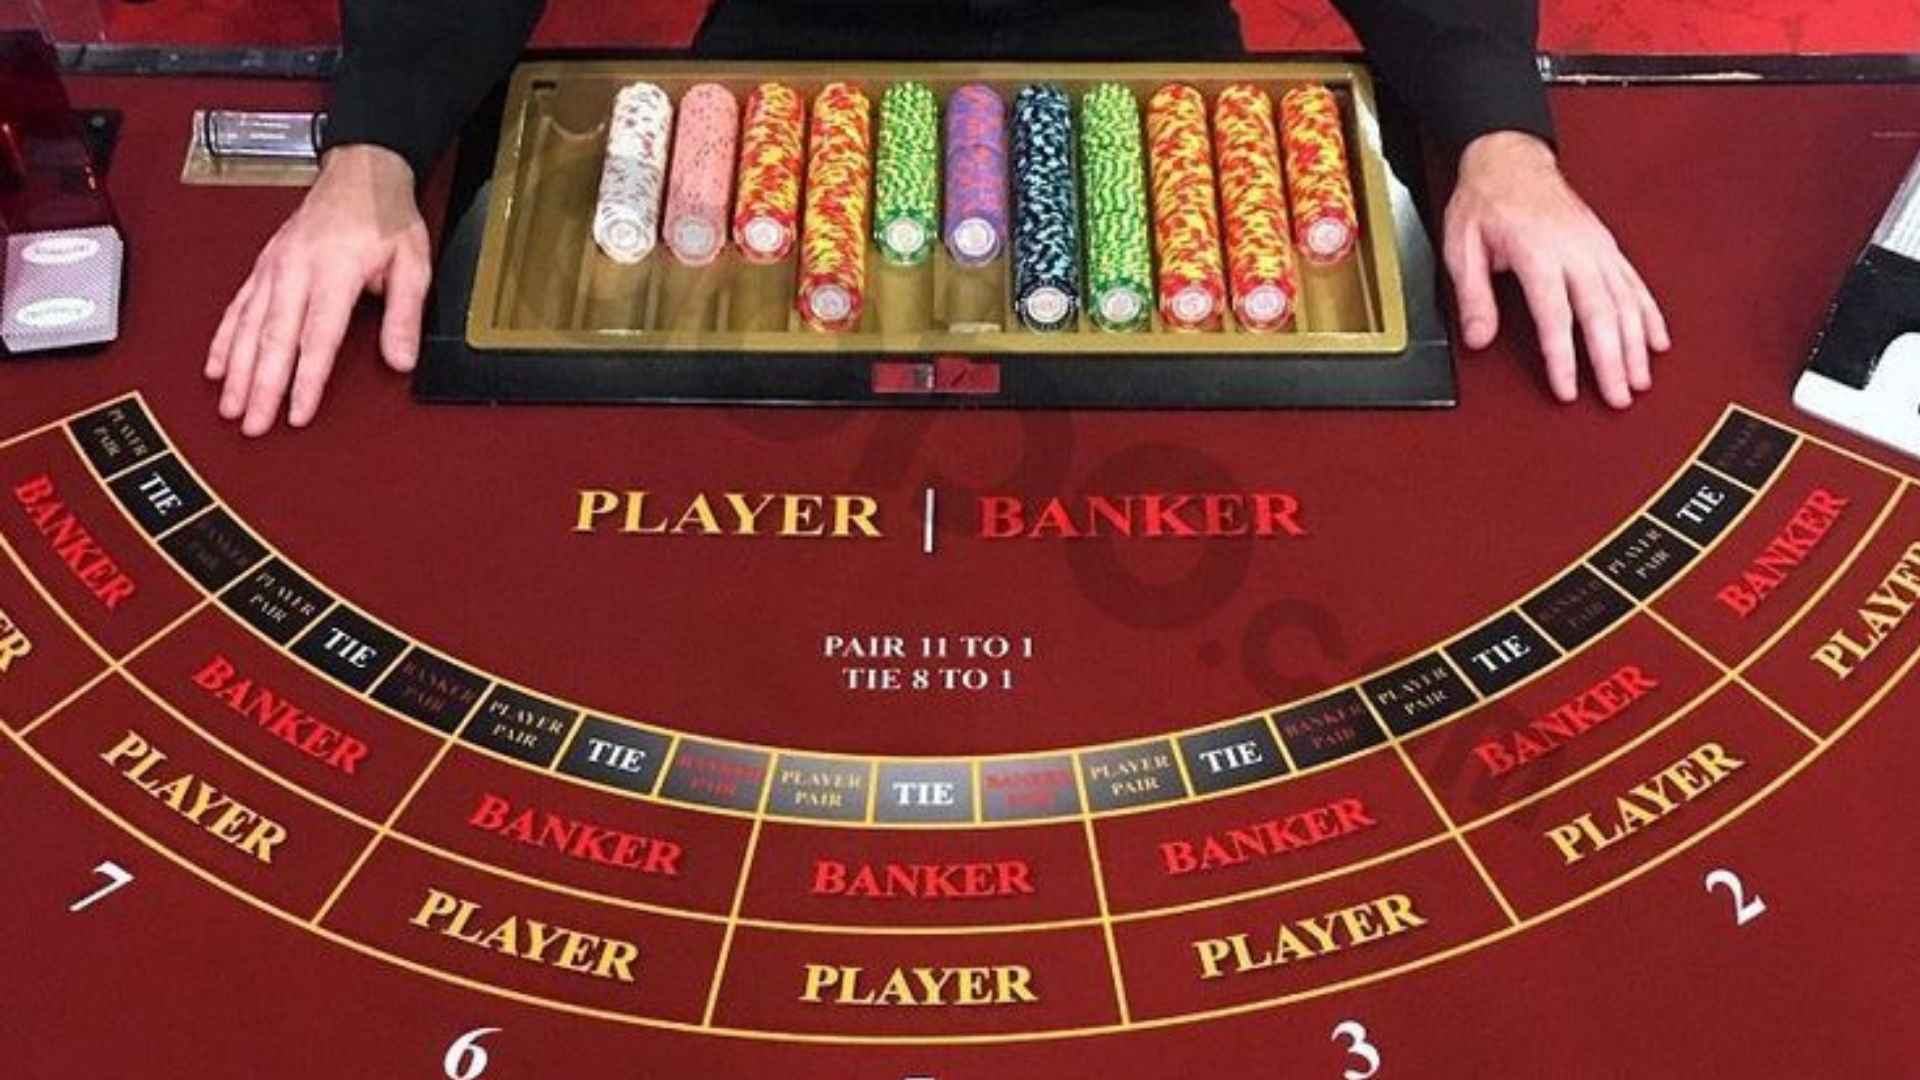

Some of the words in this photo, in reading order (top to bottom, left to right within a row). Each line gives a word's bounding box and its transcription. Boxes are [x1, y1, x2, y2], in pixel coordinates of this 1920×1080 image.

[139, 472, 182, 516] TIE
[571, 488, 884, 538] PLAYER
[976, 493, 1307, 540] BANKER
[1676, 484, 1726, 525] TIE
[15, 472, 136, 609] BANKER
[1716, 486, 1850, 618] BANKER
[322, 627, 377, 669] TIE
[823, 634, 906, 659] PAIR
[920, 634, 949, 659] 11
[960, 634, 1010, 659] TO
[1021, 634, 1035, 659] 1
[1470, 634, 1532, 675] TIE
[842, 667, 902, 691] TIE
[911, 667, 930, 691] 8
[939, 667, 990, 691] TO
[1000, 667, 1013, 691] 1
[1377, 666, 1449, 707] PLAYER
[192, 655, 369, 774] BANKER
[489, 699, 564, 736] PLAYER
[1403, 689, 1449, 717] PAIR
[1472, 664, 1660, 779] BANKER
[491, 722, 539, 749] PAIR
[587, 736, 648, 774] TIE
[780, 767, 863, 790] PLAYER
[1089, 754, 1171, 781] PLAYER
[1199, 740, 1263, 775] TIE
[101, 728, 288, 865] PLAYER
[794, 789, 843, 808] PAIR
[892, 781, 957, 807] TIE
[1111, 775, 1161, 797] PAIR
[1544, 740, 1745, 865] PLAYER
[468, 791, 683, 876] BANKER
[1158, 796, 1377, 876] BANKER
[69, 860, 135, 912] 7
[811, 858, 1036, 898] BANKER
[1705, 867, 1768, 927] 2
[409, 888, 639, 984] PLAYER
[1192, 892, 1428, 980] PLAYER
[798, 962, 1038, 1006] PLAYER
[444, 1028, 503, 1080] 6
[1331, 1020, 1380, 1080] 3
